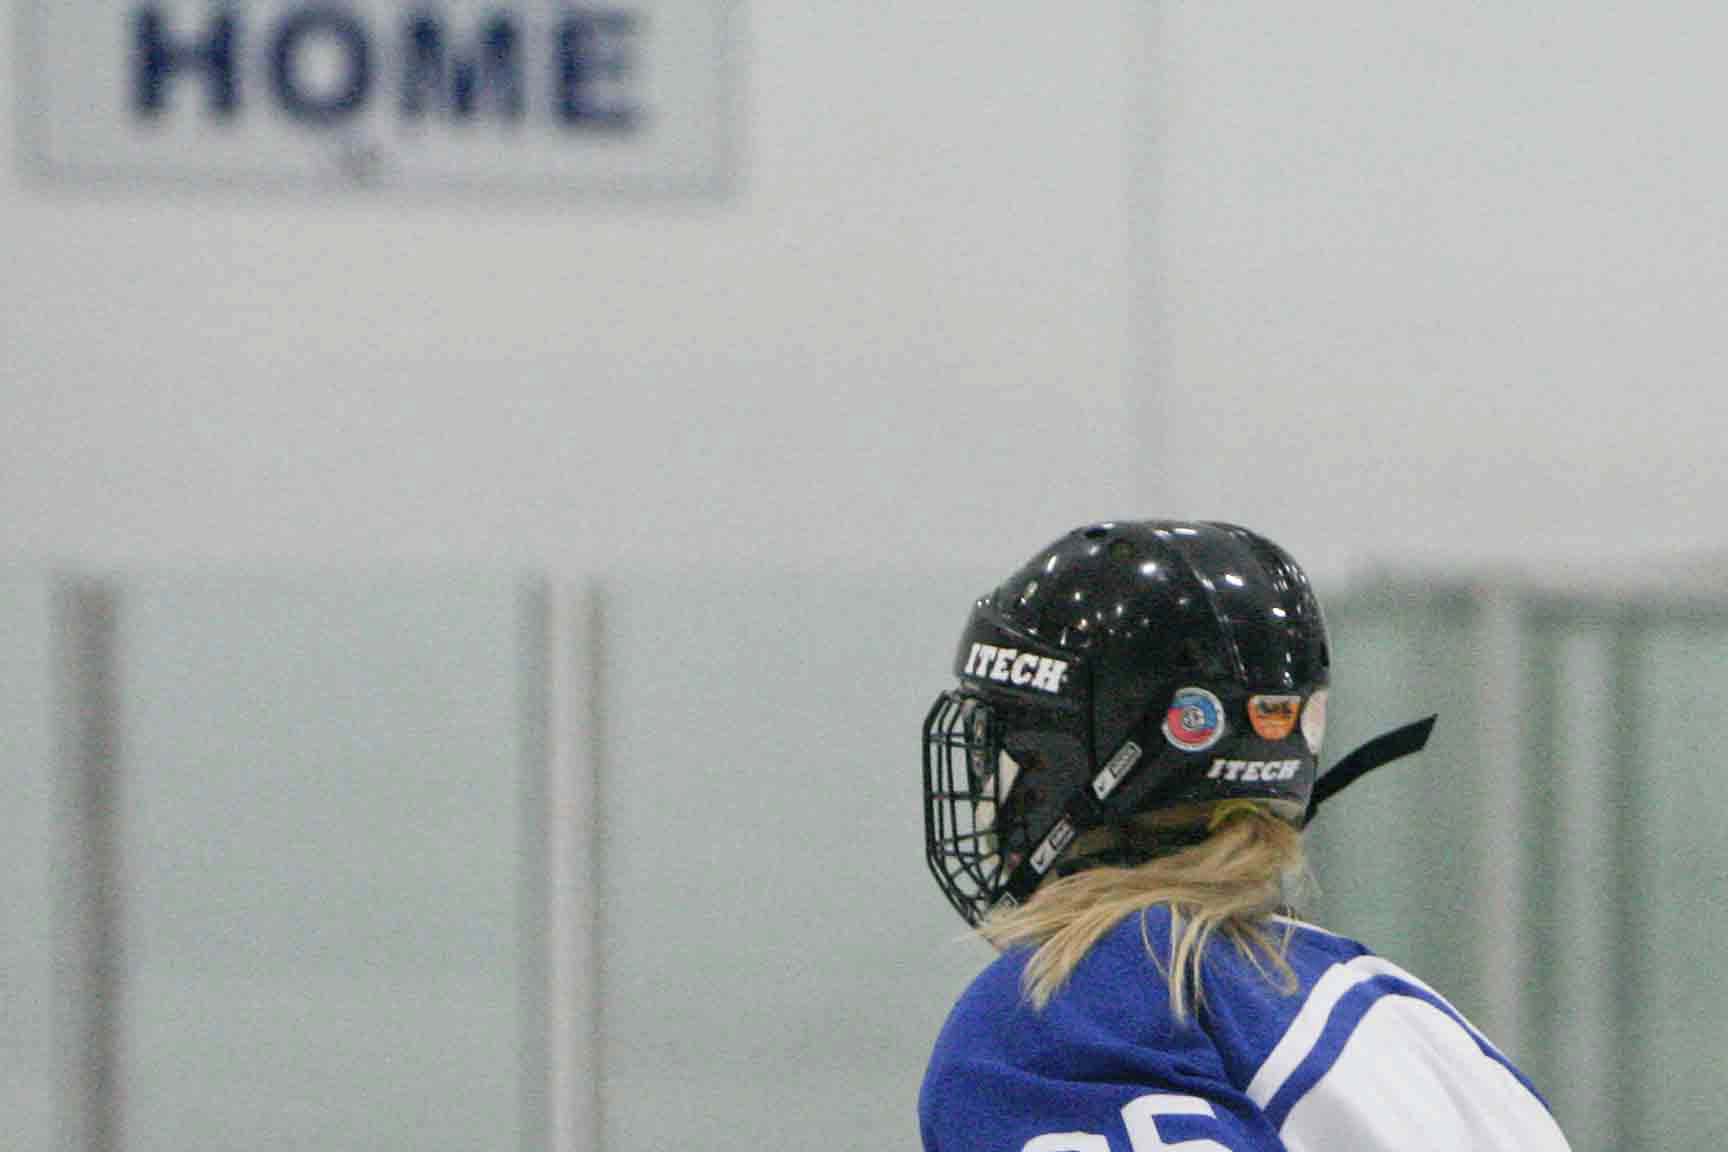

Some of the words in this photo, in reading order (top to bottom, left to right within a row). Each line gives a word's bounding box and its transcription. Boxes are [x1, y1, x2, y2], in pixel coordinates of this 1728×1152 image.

[128, 4, 645, 132] HOME
[964, 641, 1069, 693] ITECH
[1207, 758, 1302, 782] ITECH
